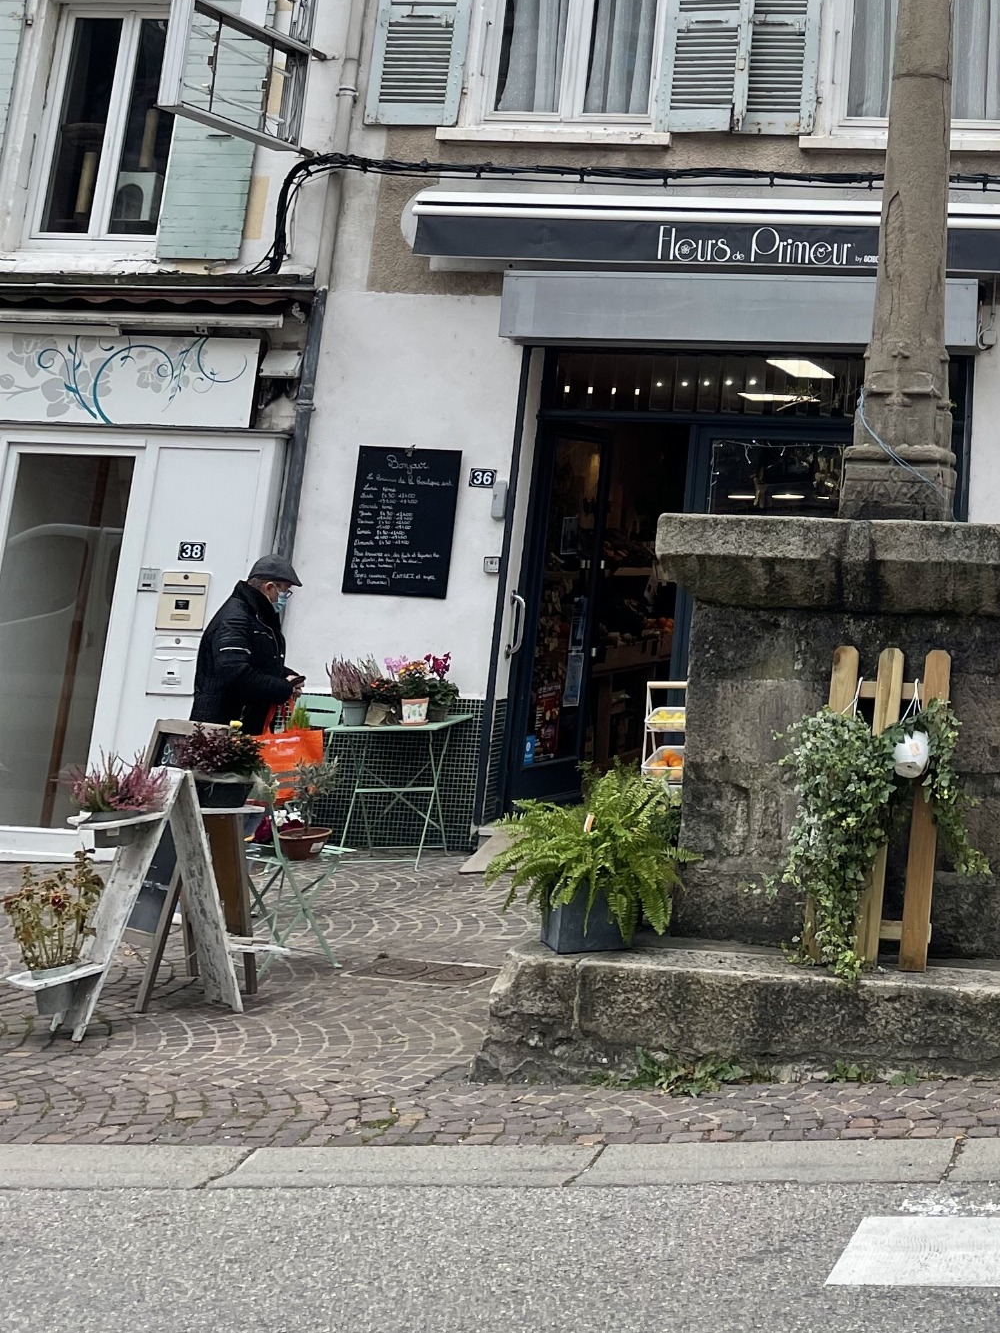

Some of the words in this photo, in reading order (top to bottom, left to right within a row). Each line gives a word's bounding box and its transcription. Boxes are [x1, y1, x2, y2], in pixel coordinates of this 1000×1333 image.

[657, 225, 731, 262] Fleurs
[732, 252, 745, 262] de
[750, 226, 852, 266] Primeur
[473, 471, 492, 485] 36
[182, 544, 202, 558] 38
